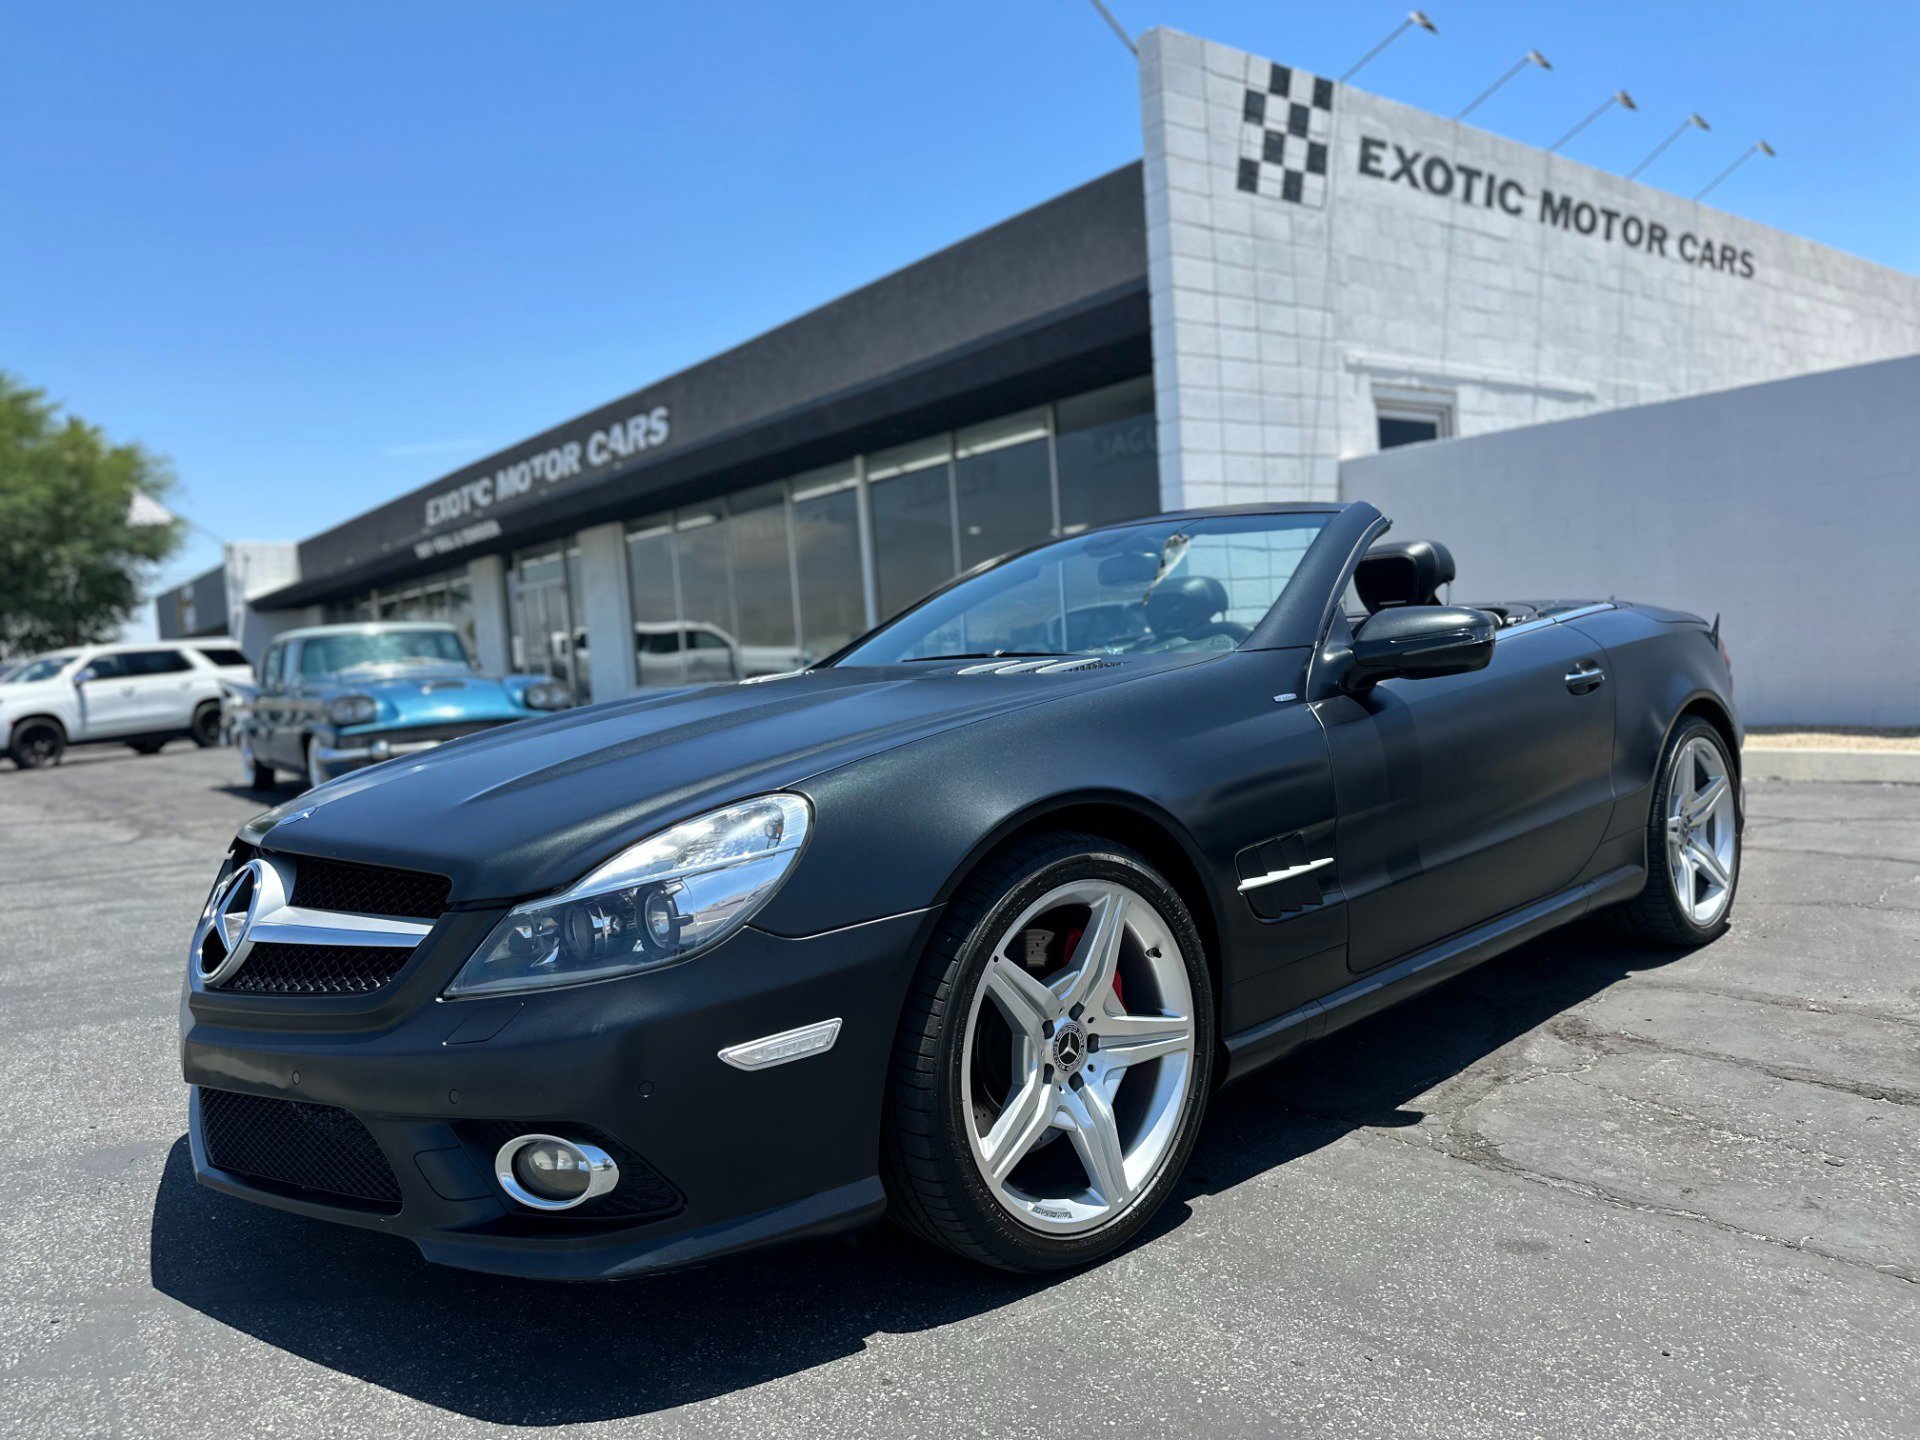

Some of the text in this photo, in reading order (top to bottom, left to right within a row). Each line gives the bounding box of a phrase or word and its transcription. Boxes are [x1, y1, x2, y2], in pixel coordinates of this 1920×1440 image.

[1358, 136, 1756, 280] EXOTIC MOTOR CARS
[495, 440, 582, 501] MOTOR
[587, 406, 670, 467] CARS
